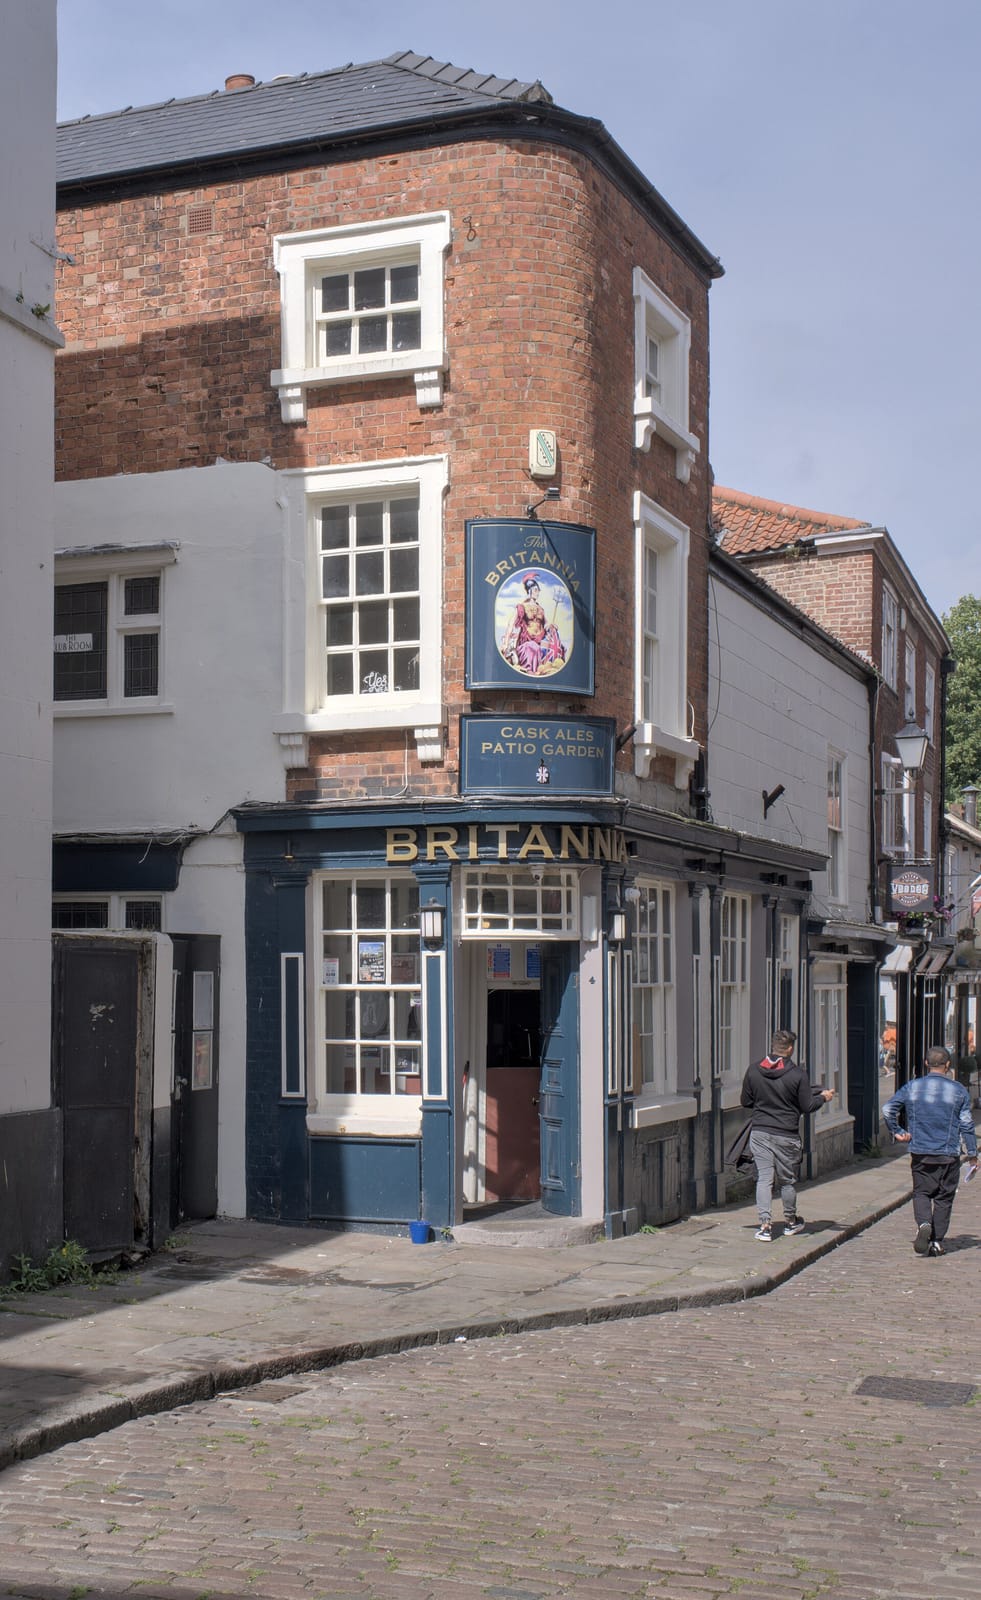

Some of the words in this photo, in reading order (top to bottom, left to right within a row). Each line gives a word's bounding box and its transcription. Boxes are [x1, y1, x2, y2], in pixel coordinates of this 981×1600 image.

[523, 535, 548, 549] The
[484, 550, 582, 592] BRITANNIA
[68, 641, 91, 650] ROOM
[500, 726, 550, 740] CASK
[554, 728, 594, 742] ALES
[481, 742, 537, 755] PATIO
[542, 744, 605, 758] GARDEN
[385, 824, 629, 864] BRITANNIA
[891, 883, 928, 895] VOODOO
[589, 976, 596, 985] 4
